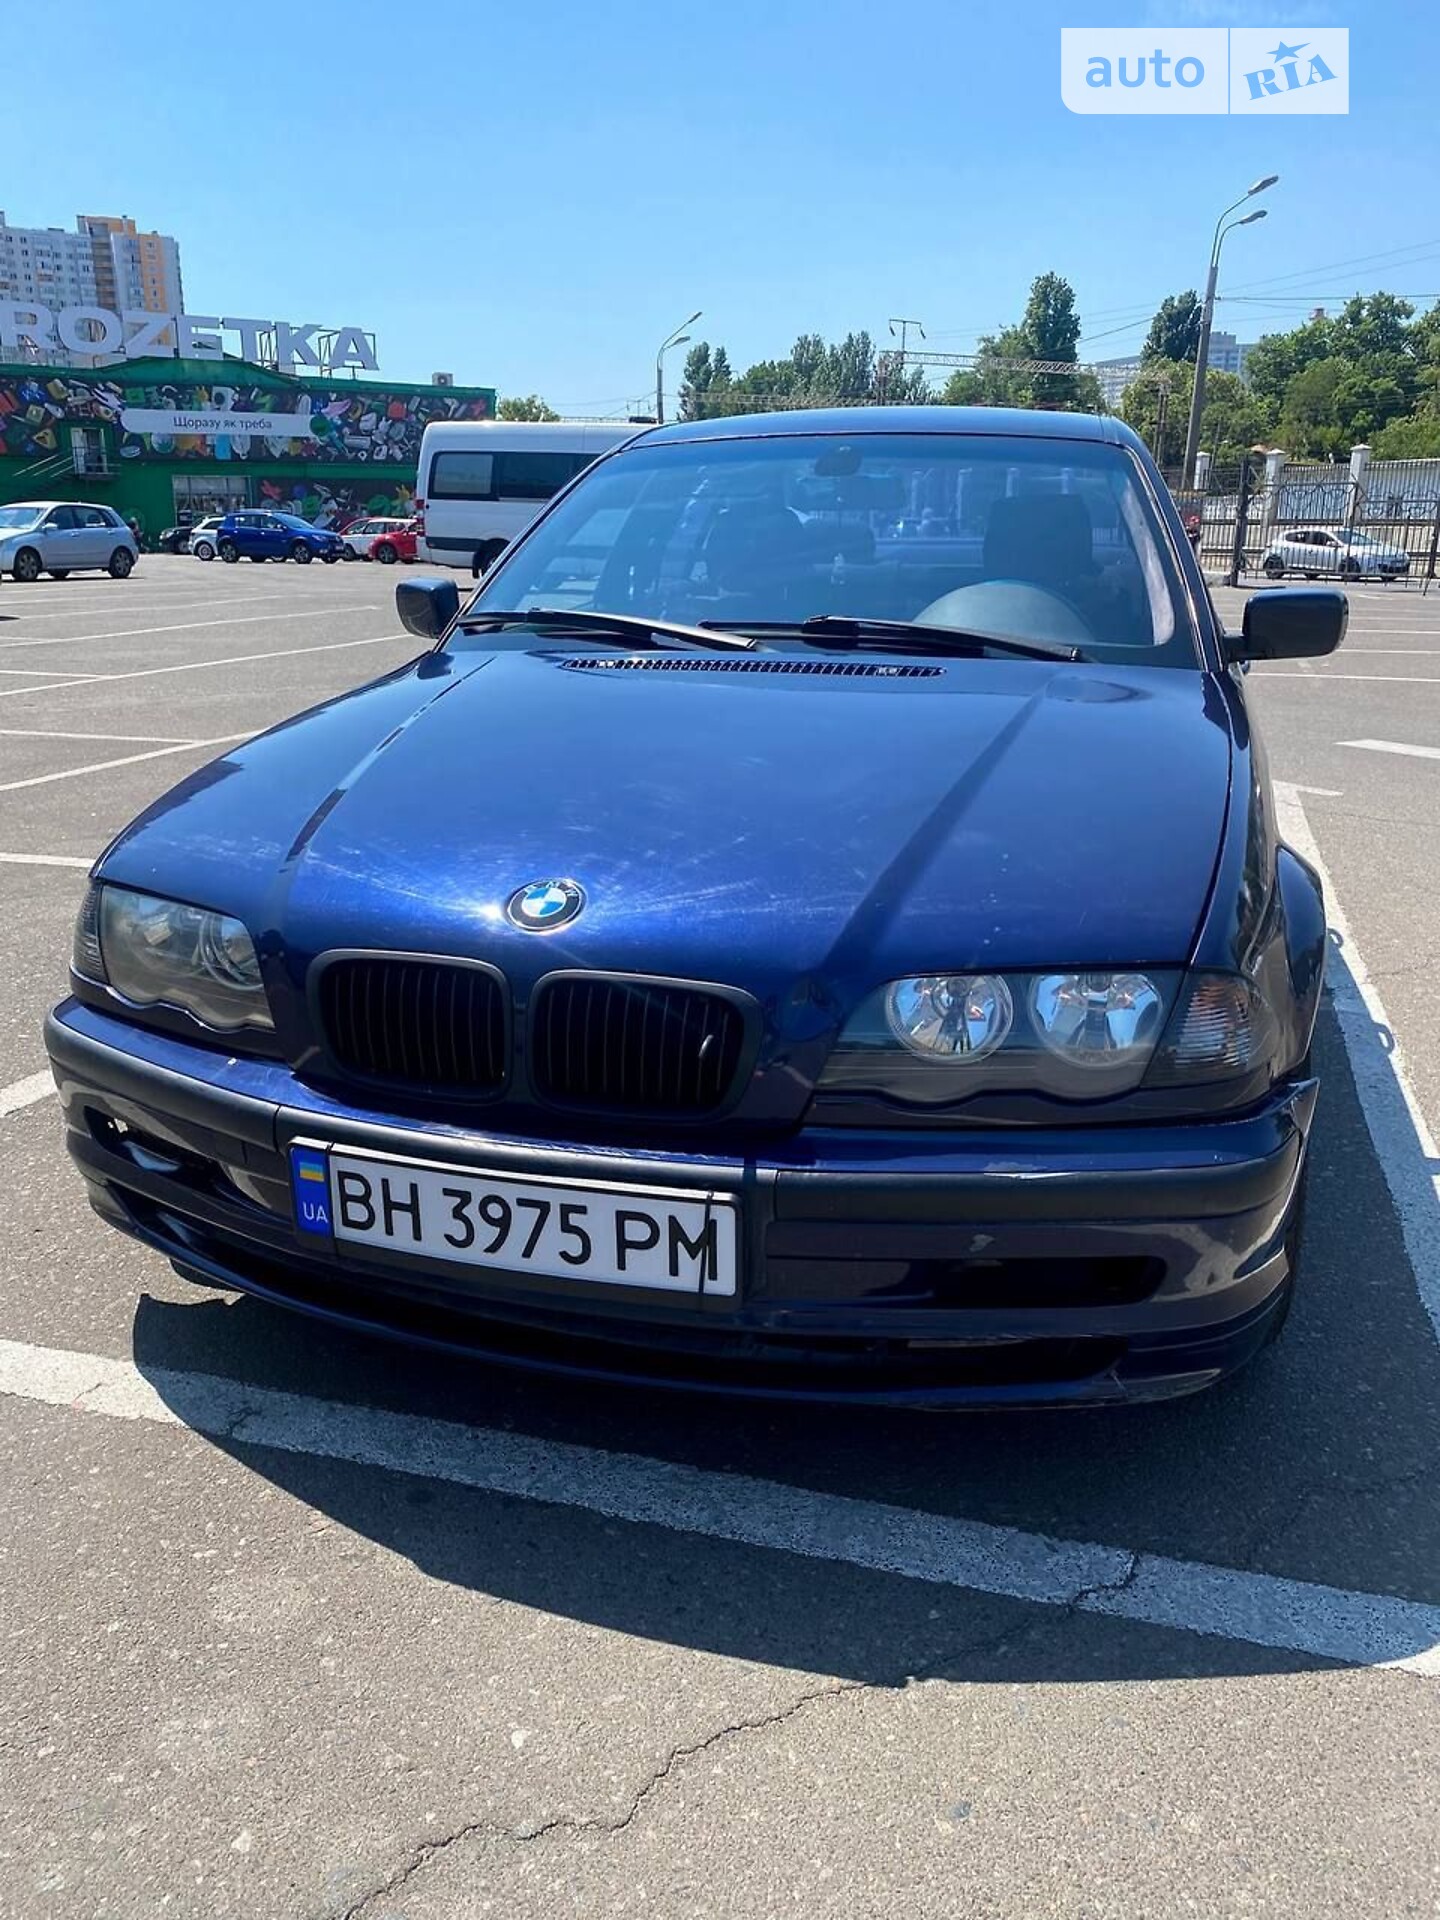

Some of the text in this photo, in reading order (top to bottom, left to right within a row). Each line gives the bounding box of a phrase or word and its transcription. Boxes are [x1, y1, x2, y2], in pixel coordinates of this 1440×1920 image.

[0, 301, 380, 372] ROZETKA
[173, 416, 273, 430] Щоразу як треба
[302, 1202, 329, 1224] UA
[336, 1169, 719, 1282] BH 3975 PM
